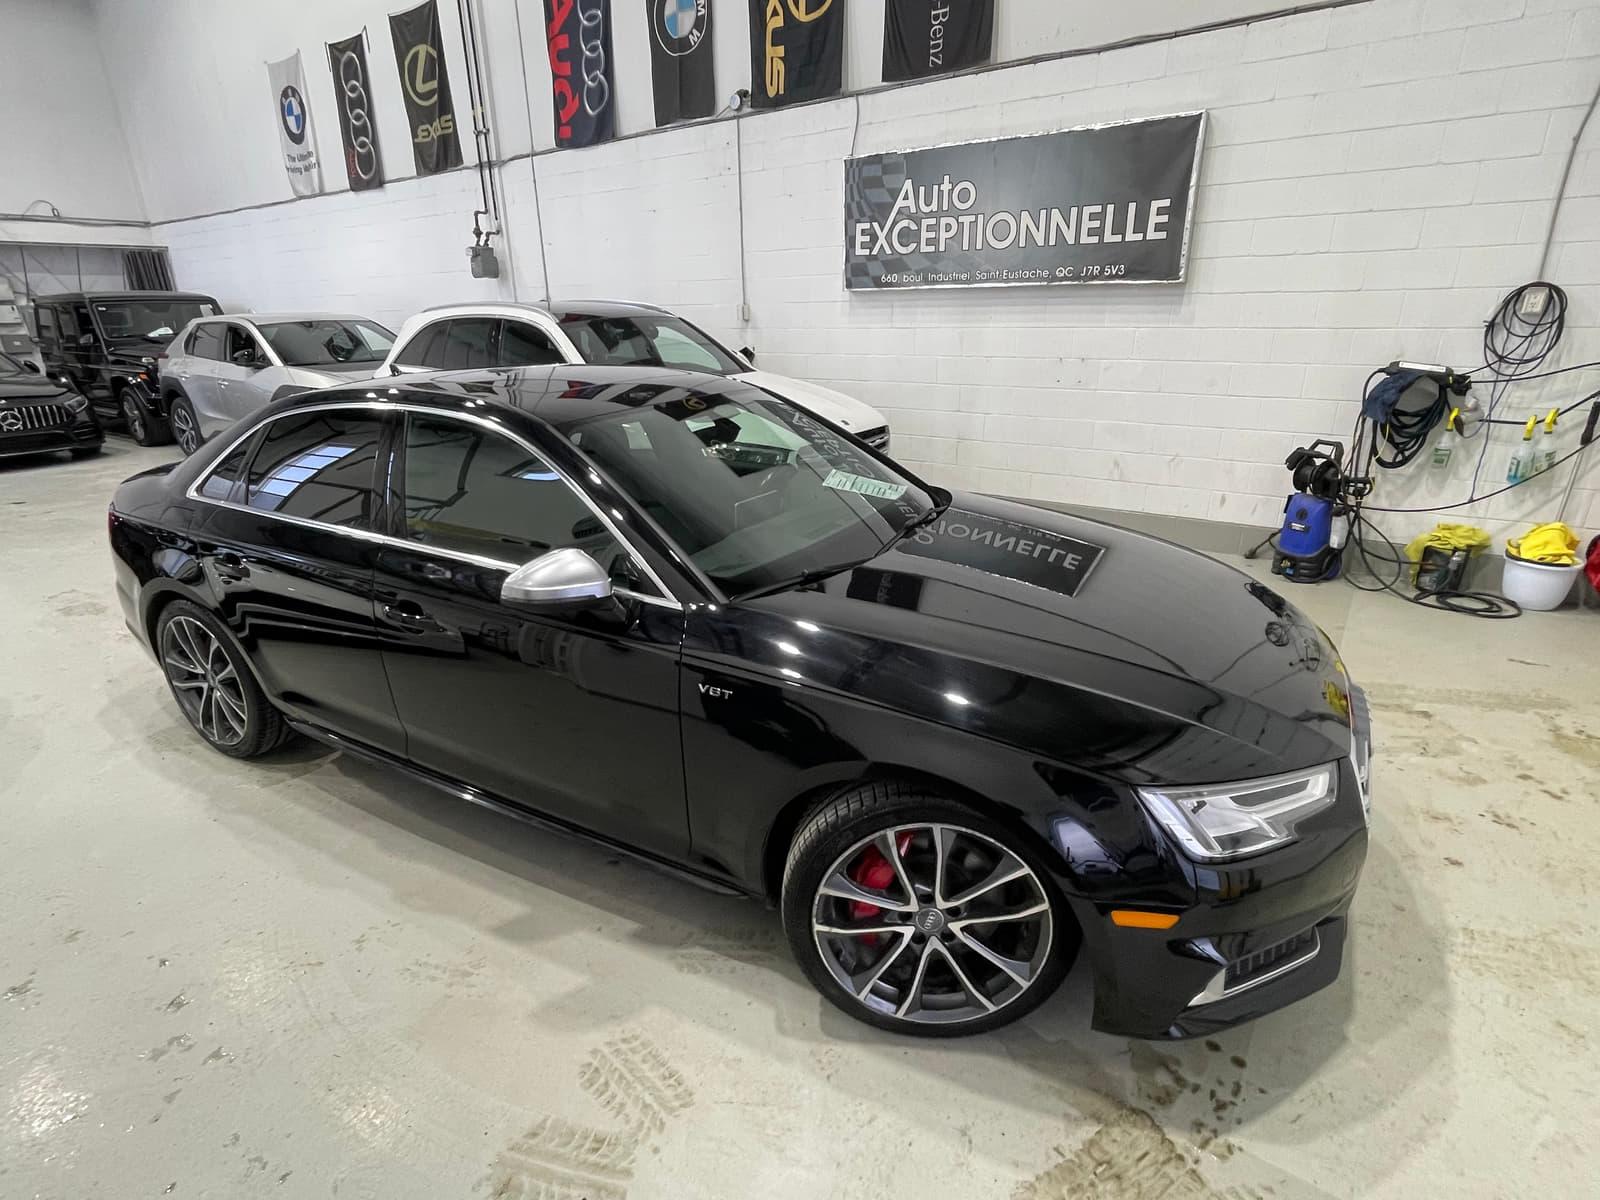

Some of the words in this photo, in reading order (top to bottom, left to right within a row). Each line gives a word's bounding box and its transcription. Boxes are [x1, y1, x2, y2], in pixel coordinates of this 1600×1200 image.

[892, 174, 977, 215] Auto
[854, 197, 1172, 257] EXCEPTIONNELLE
[1055, 266, 1074, 278] QC
[1080, 265, 1101, 277] J7R
[1104, 264, 1126, 276] 5V3
